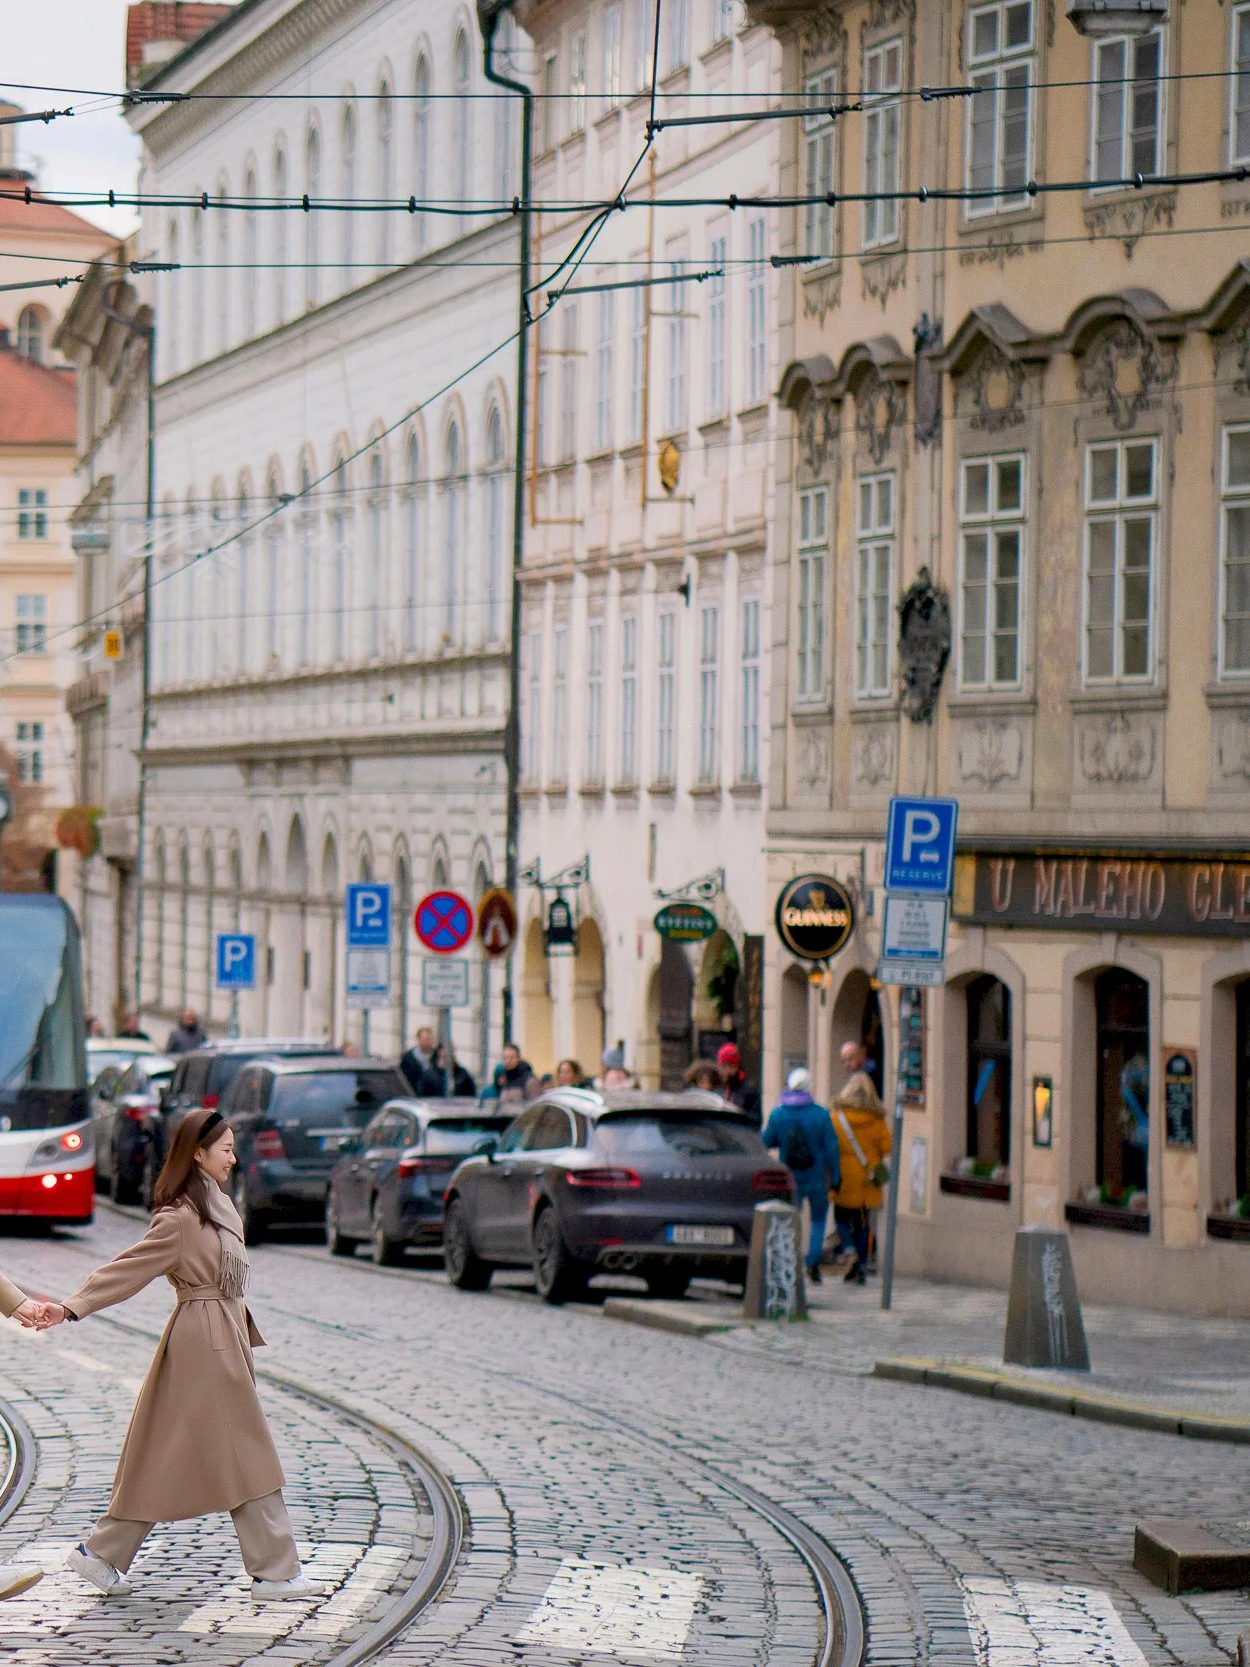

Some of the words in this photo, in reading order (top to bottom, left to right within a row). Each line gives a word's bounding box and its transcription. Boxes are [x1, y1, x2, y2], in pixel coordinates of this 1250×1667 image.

[902, 810, 941, 862] P
[990, 858, 1016, 913] U
[355, 891, 382, 928] P
[784, 907, 848, 927] GUINNESS
[224, 940, 248, 972] P
